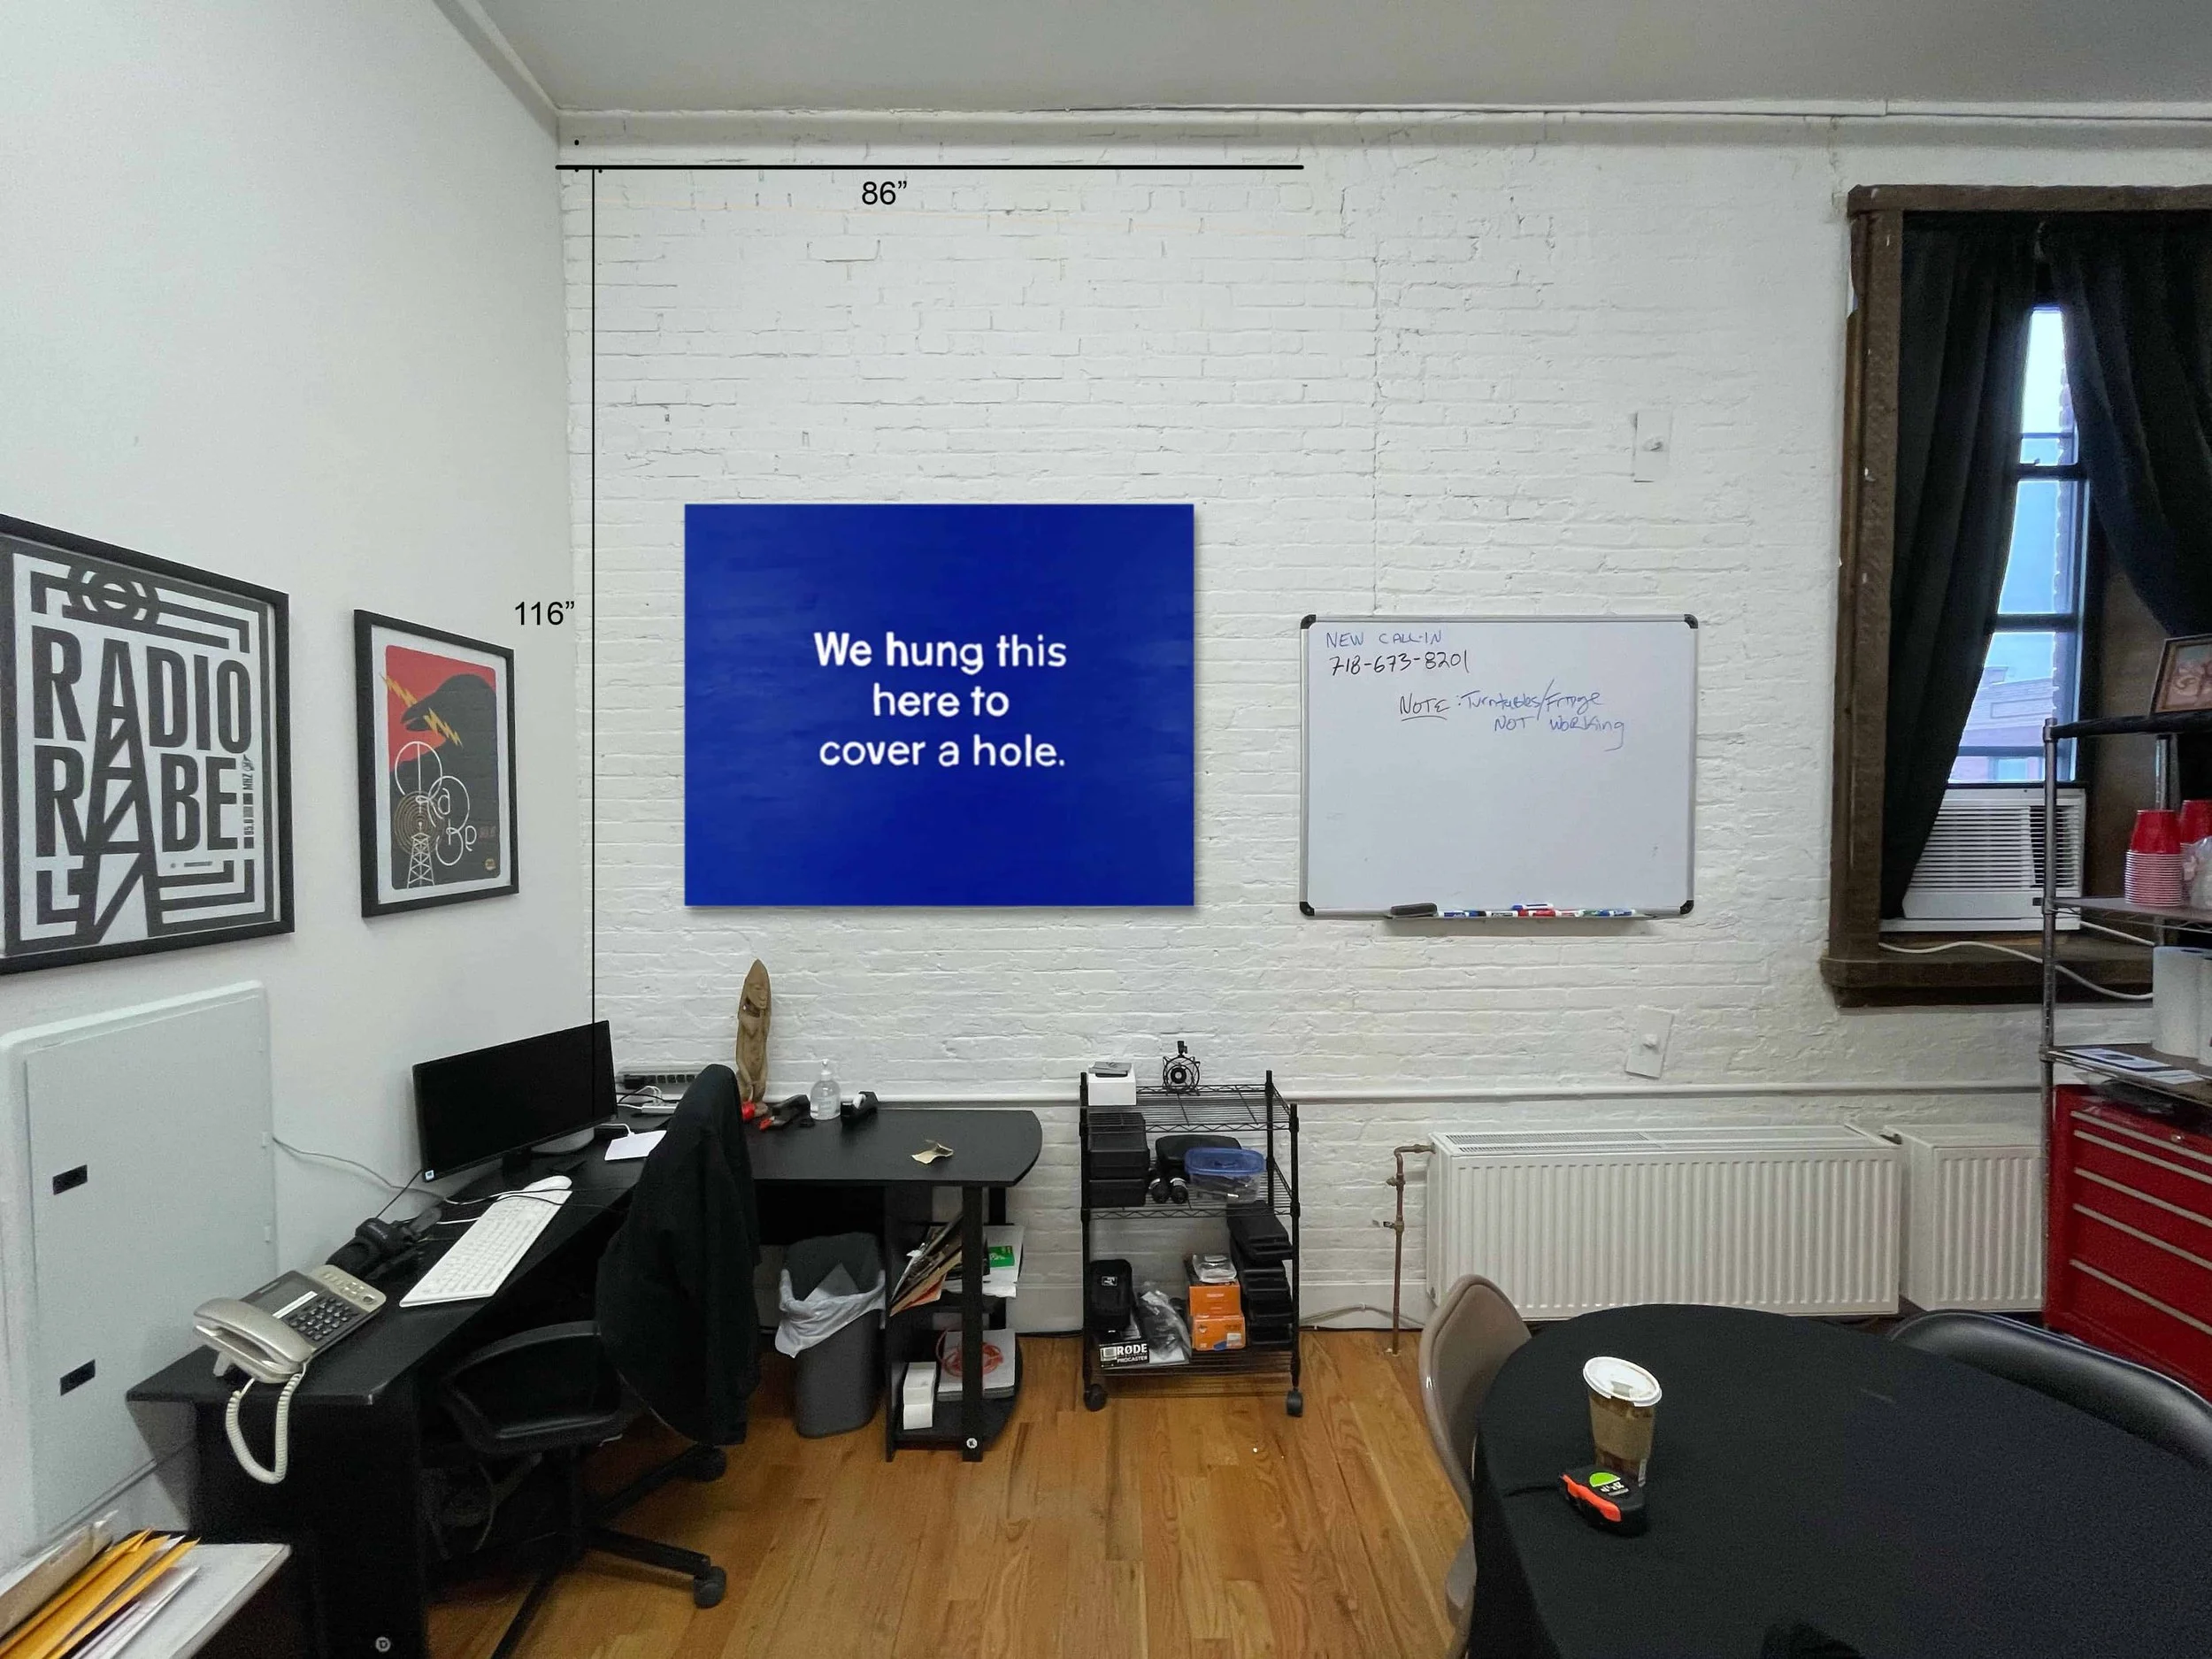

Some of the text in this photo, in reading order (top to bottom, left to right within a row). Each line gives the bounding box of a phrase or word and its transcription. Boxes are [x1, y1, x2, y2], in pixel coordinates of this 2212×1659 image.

[813, 631, 1066, 675] We hung this
[1325, 631, 1442, 648] NEW CALL-IN
[1329, 649, 1471, 677] 718-673-8201
[32, 625, 252, 755] RADIO
[873, 682, 1010, 717] here to
[1494, 715, 1535, 733] NOT
[819, 733, 1064, 767] cover a hole.
[1117, 1343, 1148, 1356] RØDE
